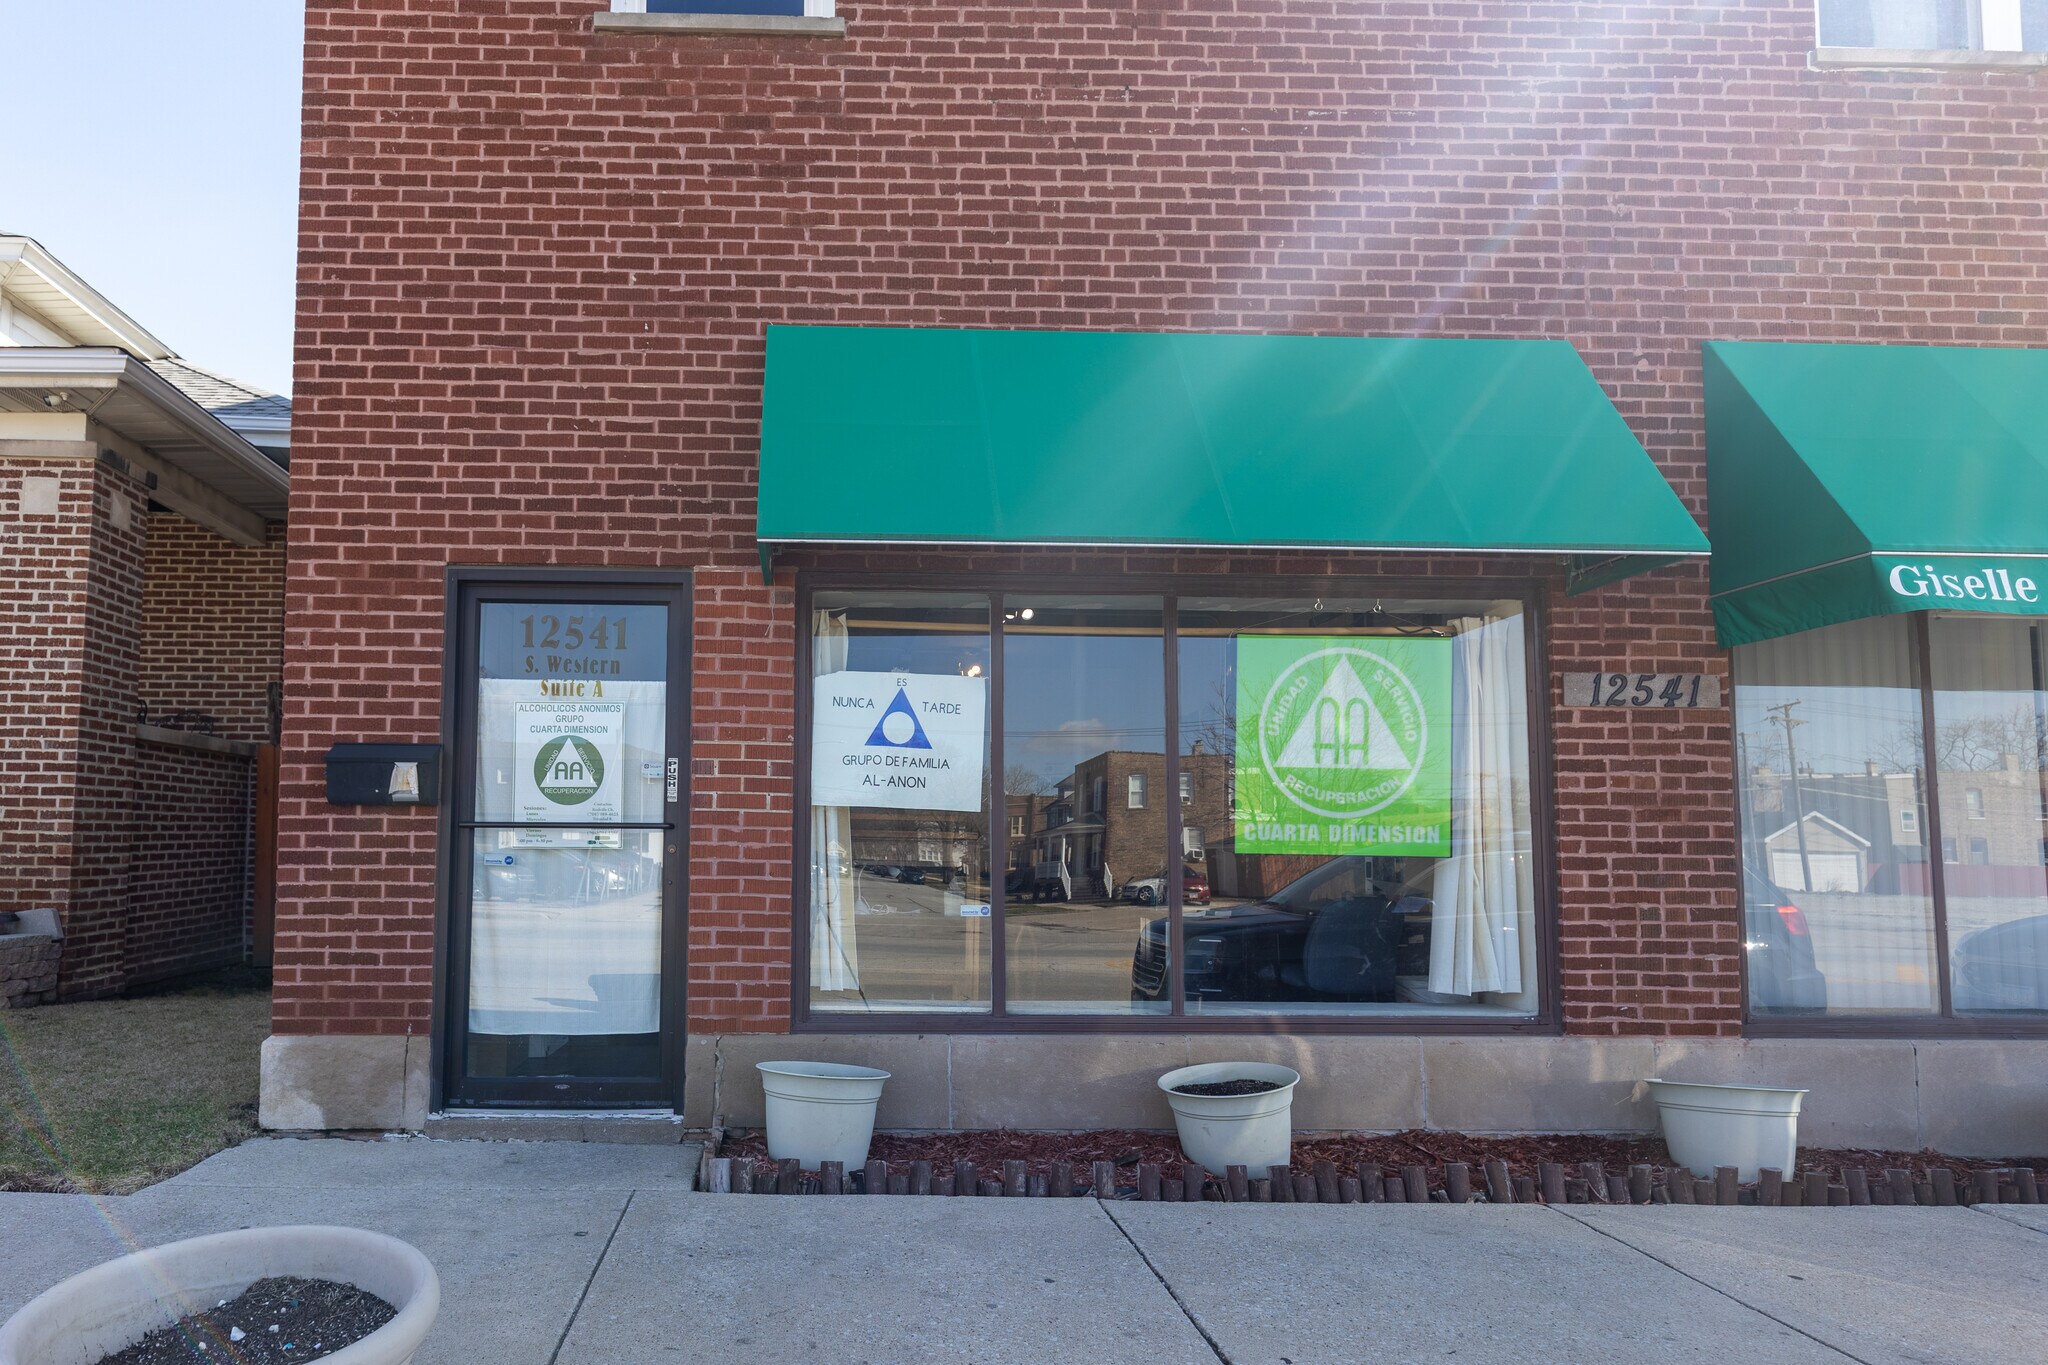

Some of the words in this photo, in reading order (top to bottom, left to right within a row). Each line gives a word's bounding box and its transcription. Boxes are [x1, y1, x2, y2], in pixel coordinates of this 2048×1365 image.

[1889, 564, 2039, 603] Giselle
[520, 614, 628, 650] 12541
[525, 655, 539, 674] S.
[546, 655, 621, 675] Western
[540, 679, 586, 698] Suite
[592, 680, 603, 698] A
[896, 677, 908, 687] ES
[1590, 672, 1701, 707] 12541
[518, 704, 577, 713] ALCOHOLICOS
[577, 704, 622, 713] ANONIMOS
[832, 696, 875, 709] NUNCA
[922, 701, 962, 715] TARDE
[1267, 674, 1310, 738] UNIDAD
[1373, 668, 1418, 743] SERVICIO
[555, 714, 585, 723] GRUPO
[529, 725, 563, 734] CUARTA
[563, 725, 609, 734] DIMENSION
[1312, 696, 1371, 766] AA
[543, 749, 559, 772] UNIDAD
[577, 747, 596, 775] SERVICIO
[842, 754, 883, 766] GRUPO
[885, 756, 900, 767] DE
[902, 757, 951, 770] FAMILIA
[554, 761, 584, 781] AA
[668, 760, 677, 788] PUSH
[862, 774, 927, 789] AL-ANON
[1283, 773, 1403, 805] RECUPERACION
[1244, 823, 1321, 842] CUARTA
[1328, 824, 1441, 844] DIMENSION
